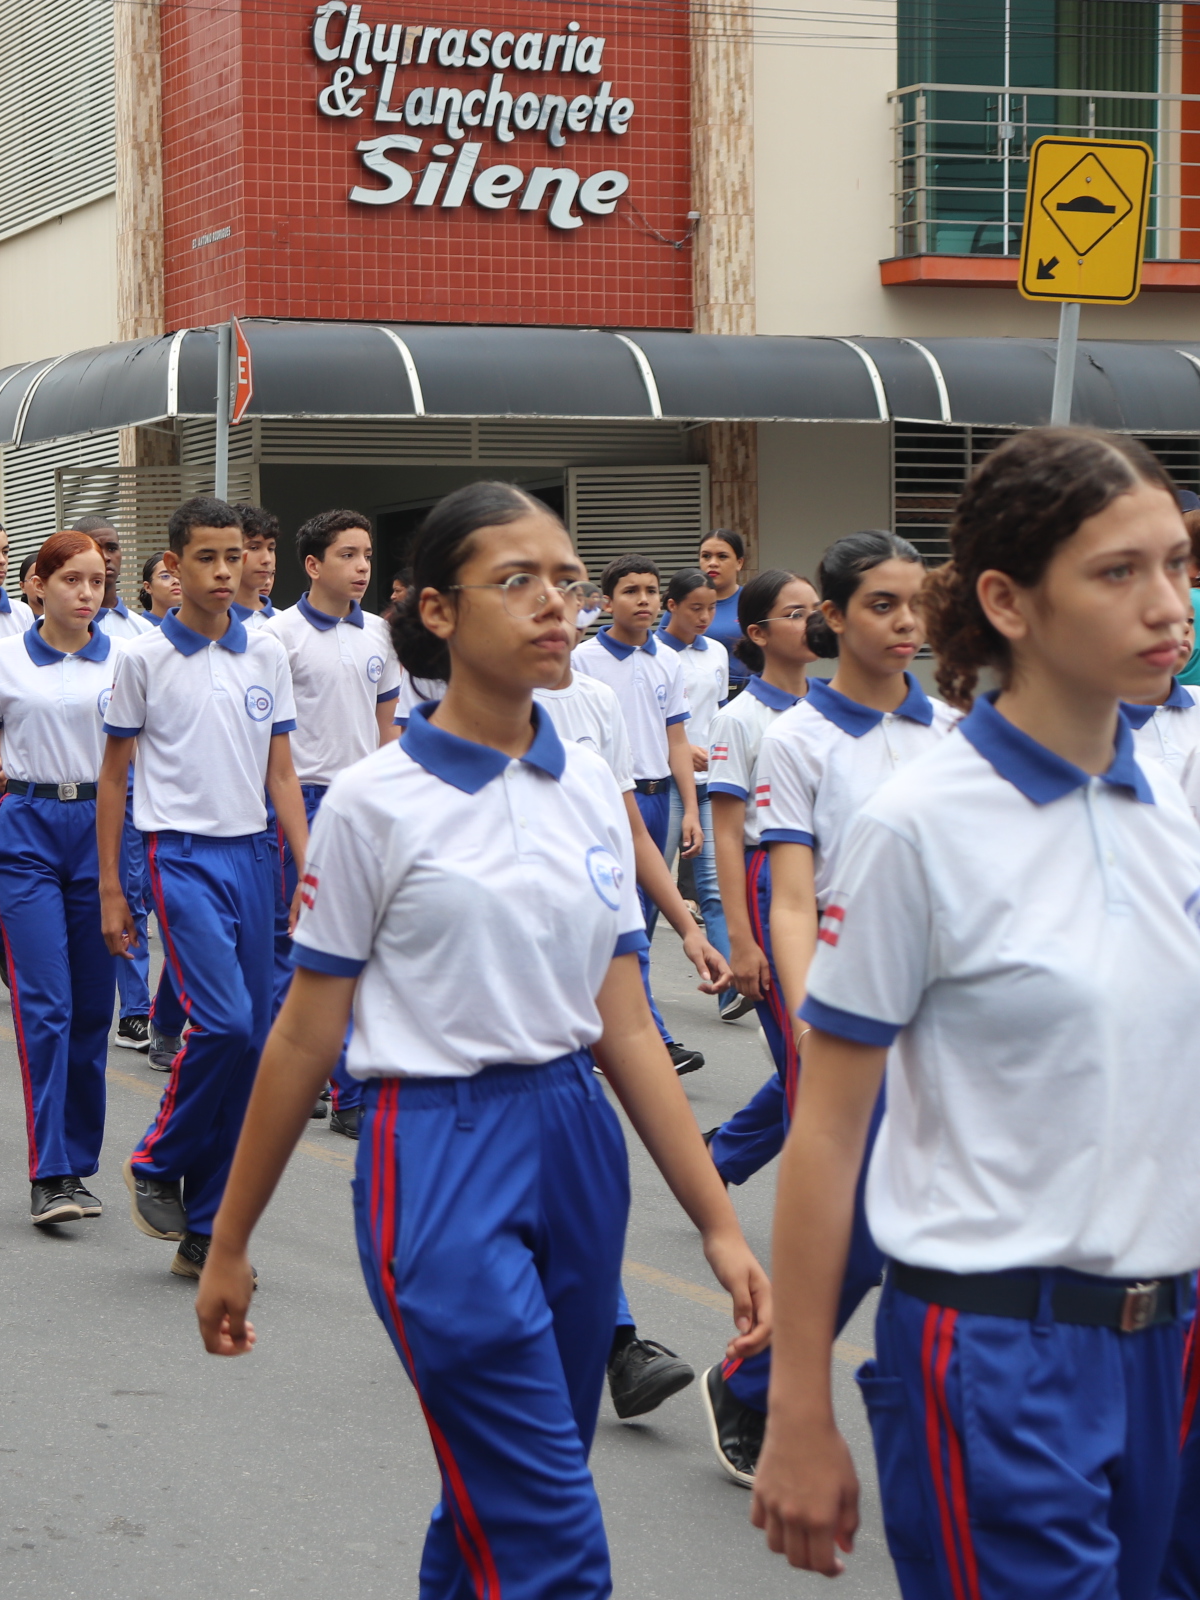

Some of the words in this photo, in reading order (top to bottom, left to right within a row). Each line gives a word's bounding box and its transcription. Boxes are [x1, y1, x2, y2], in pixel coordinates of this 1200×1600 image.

[313, 0, 606, 75] Churrascaria
[318, 66, 367, 117] &
[374, 63, 635, 148] Lanchonete
[349, 133, 630, 230] Silene
